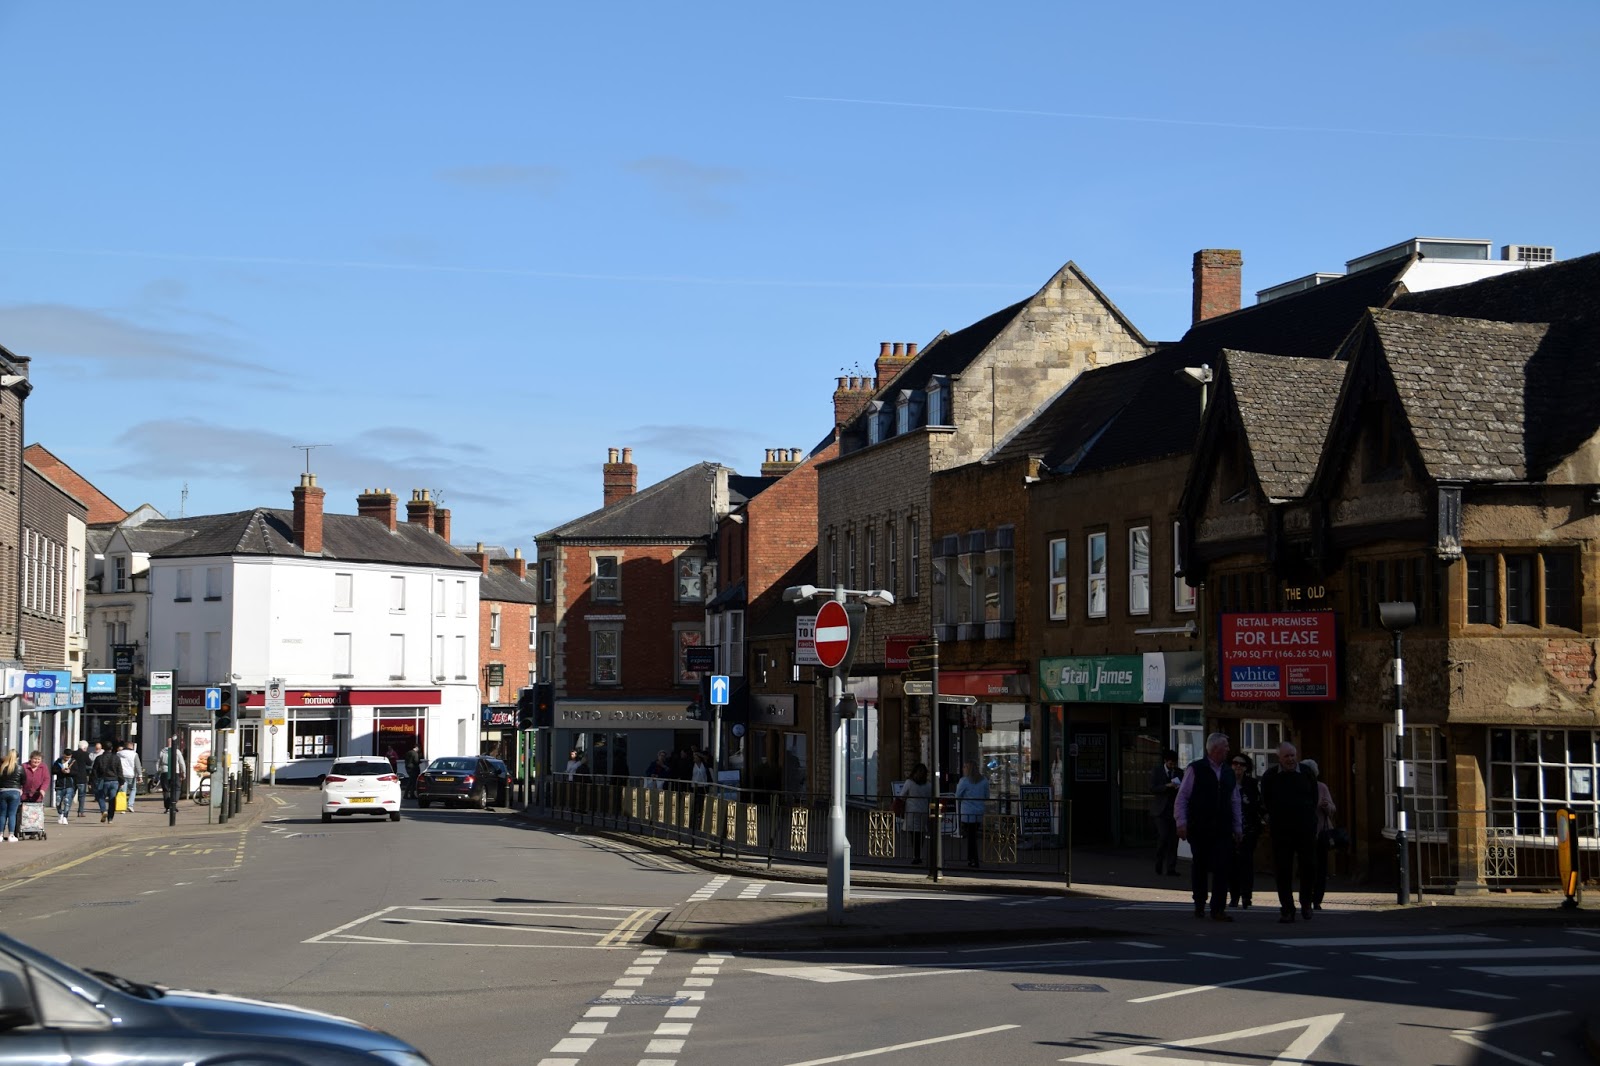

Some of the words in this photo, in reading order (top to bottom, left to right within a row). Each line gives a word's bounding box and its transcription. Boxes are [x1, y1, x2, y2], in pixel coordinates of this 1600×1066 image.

[1285, 588, 1301, 600] THE
[1307, 586, 1325, 599] OLD
[1237, 618, 1269, 626] RETAIL
[1272, 617, 1318, 626] PREMISES
[798, 628, 808, 637] TO
[1235, 632, 1266, 645] FOR
[1271, 631, 1319, 644] LEASE
[1225, 651, 1248, 659] 1,790
[1275, 650, 1307, 659] (166.26
[1309, 650, 1320, 658] SQ
[1322, 650, 1332, 658] M)
[1234, 666, 1276, 680] white
[1061, 667, 1089, 684] Stan
[1091, 667, 1132, 692] James
[304, 694, 342, 705] northwood
[562, 710, 602, 721] PINTO
[608, 710, 663, 721] LOUNGE
